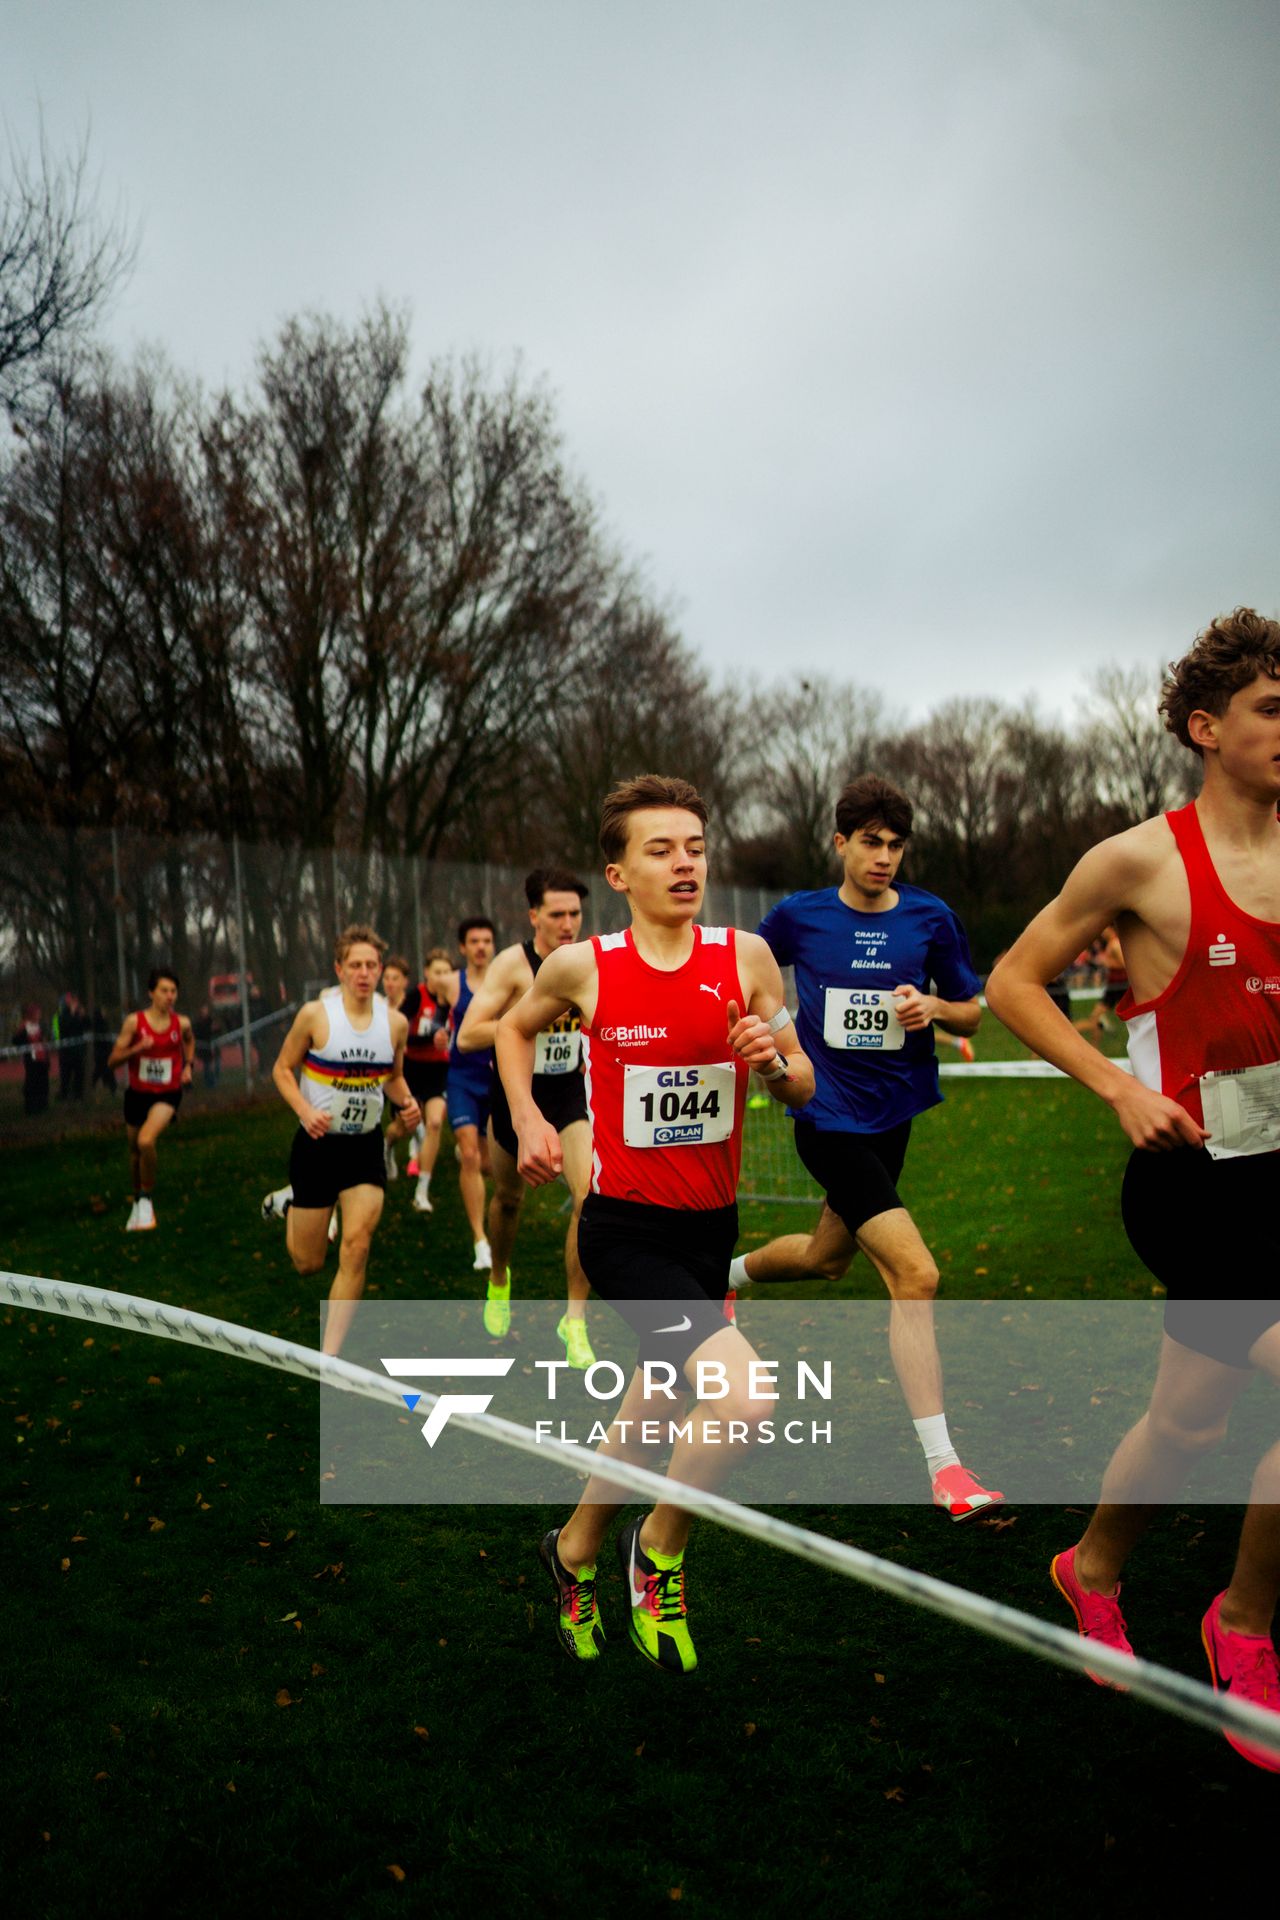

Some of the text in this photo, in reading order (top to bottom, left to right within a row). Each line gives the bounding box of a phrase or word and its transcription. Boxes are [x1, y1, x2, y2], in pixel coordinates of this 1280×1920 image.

[854, 931, 882, 939] CRAFT
[851, 959, 892, 970] Rülzheim
[843, 1009, 889, 1031] 839
[616, 1025, 668, 1041] Brillux
[618, 1040, 649, 1048] Münster
[861, 1036, 882, 1044] PLAN
[544, 1045, 571, 1061] 106
[640, 1090, 720, 1122] 1044
[340, 1107, 368, 1121] 471
[674, 1127, 701, 1137] PLAN
